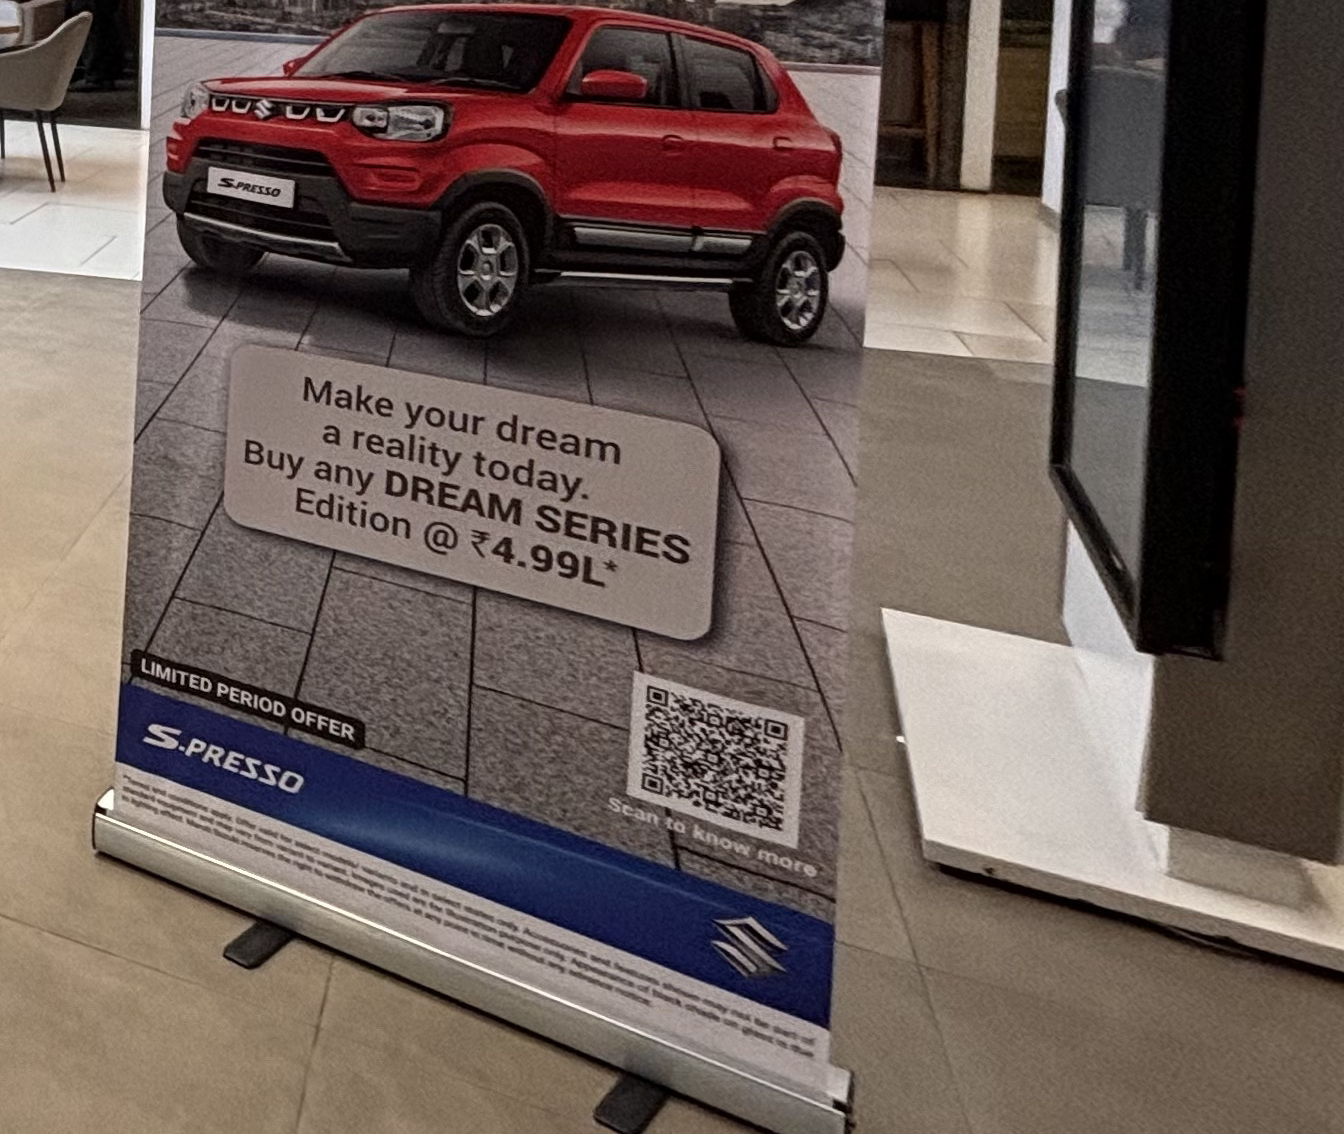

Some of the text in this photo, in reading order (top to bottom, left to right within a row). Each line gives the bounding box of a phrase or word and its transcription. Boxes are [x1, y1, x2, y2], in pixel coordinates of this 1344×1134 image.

[303, 376, 621, 465] Make your dream
[244, 439, 691, 565] Buy any DREAM SERIES
[322, 424, 589, 503] a reality today.
[295, 487, 411, 540] Edition
[423, 521, 458, 556] @
[141, 658, 356, 742] LIMITED PERIOD OFFER
[607, 797, 818, 878] Scan to know more
